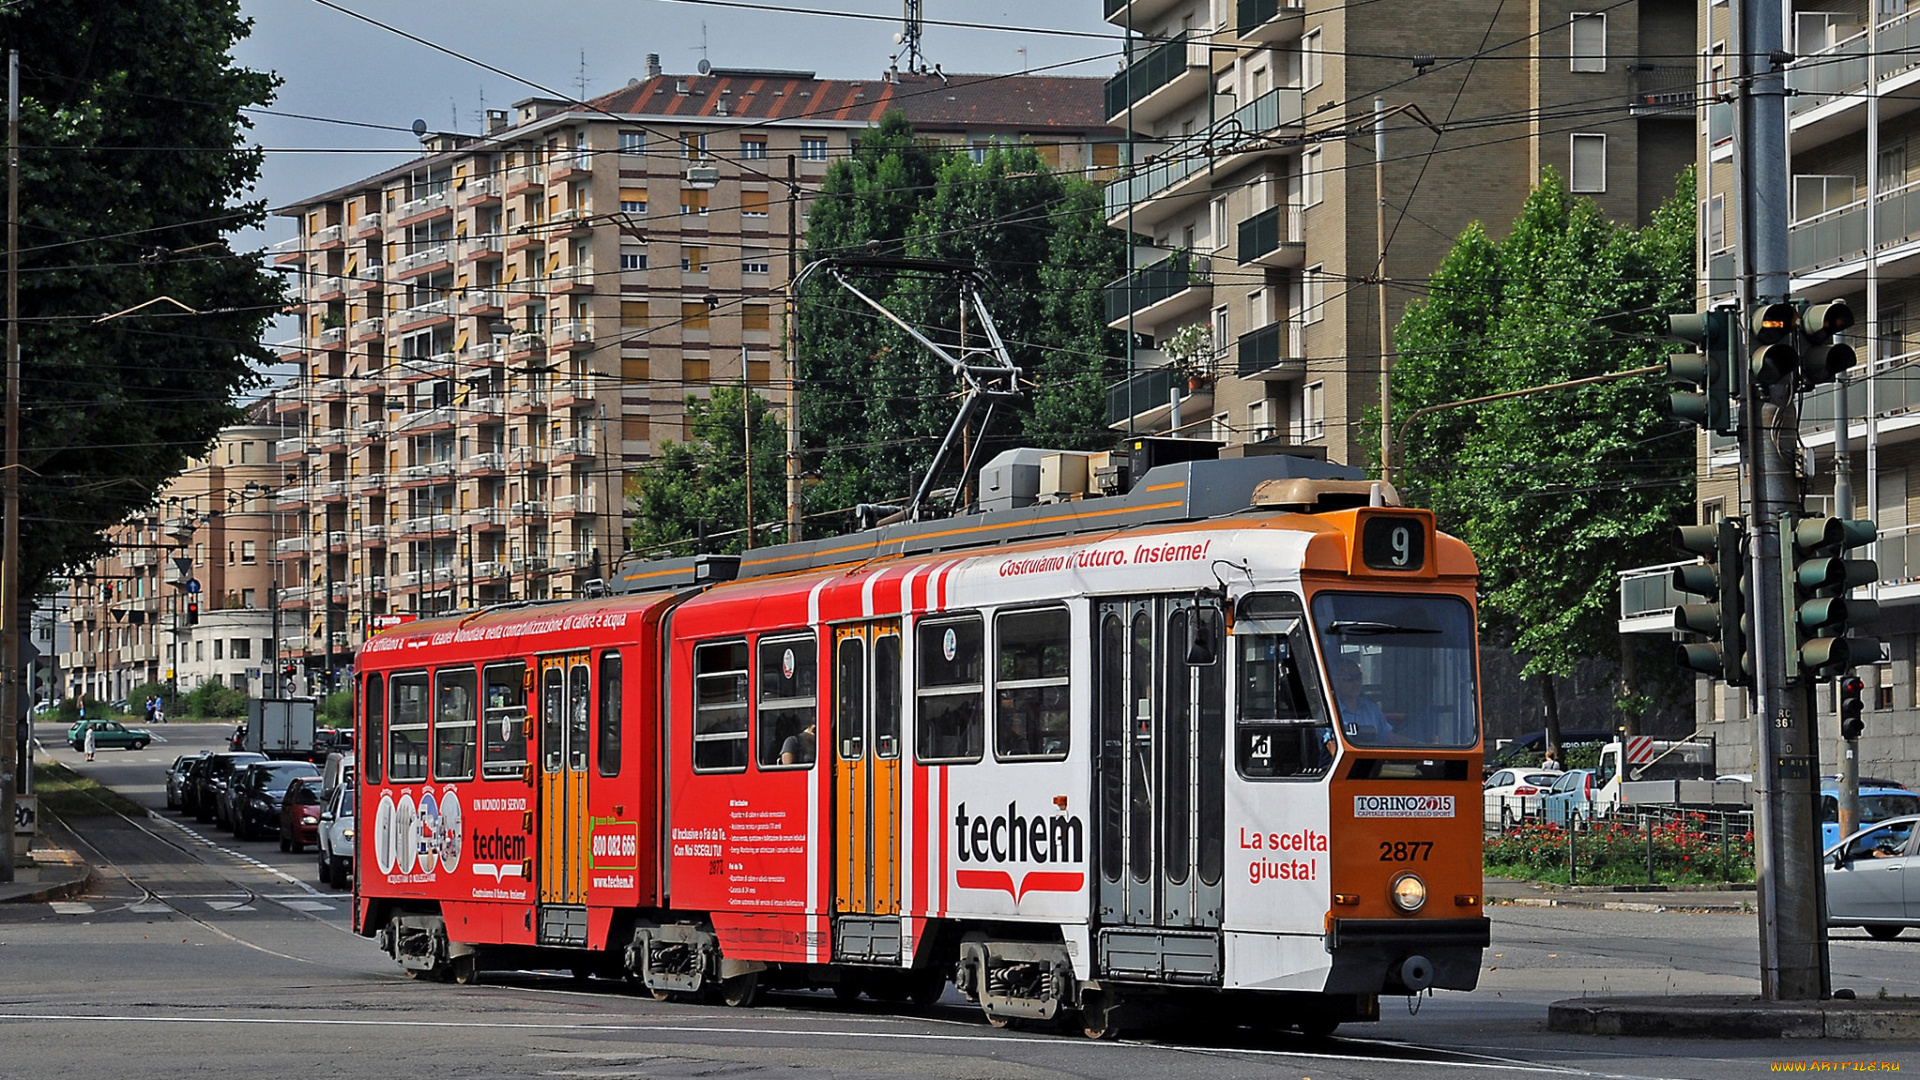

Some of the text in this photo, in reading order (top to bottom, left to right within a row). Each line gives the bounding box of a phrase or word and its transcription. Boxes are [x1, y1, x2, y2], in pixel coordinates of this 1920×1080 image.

[1392, 526, 1409, 566] 9
[999, 554, 1063, 578] Costruiamo
[1133, 539, 1211, 564] Insieme!
[603, 612, 627, 631] acqua
[1778, 708, 1792, 718] RC
[956, 799, 1083, 864] techem
[1240, 827, 1327, 851] La scelta
[473, 828, 526, 860] techem
[593, 835, 606, 856] 800
[622, 835, 636, 856] 666
[674, 844, 684, 856] Con
[1380, 842, 1434, 861] 2877
[1250, 857, 1316, 884] giusta!
[593, 875, 634, 889] www.techem.it
